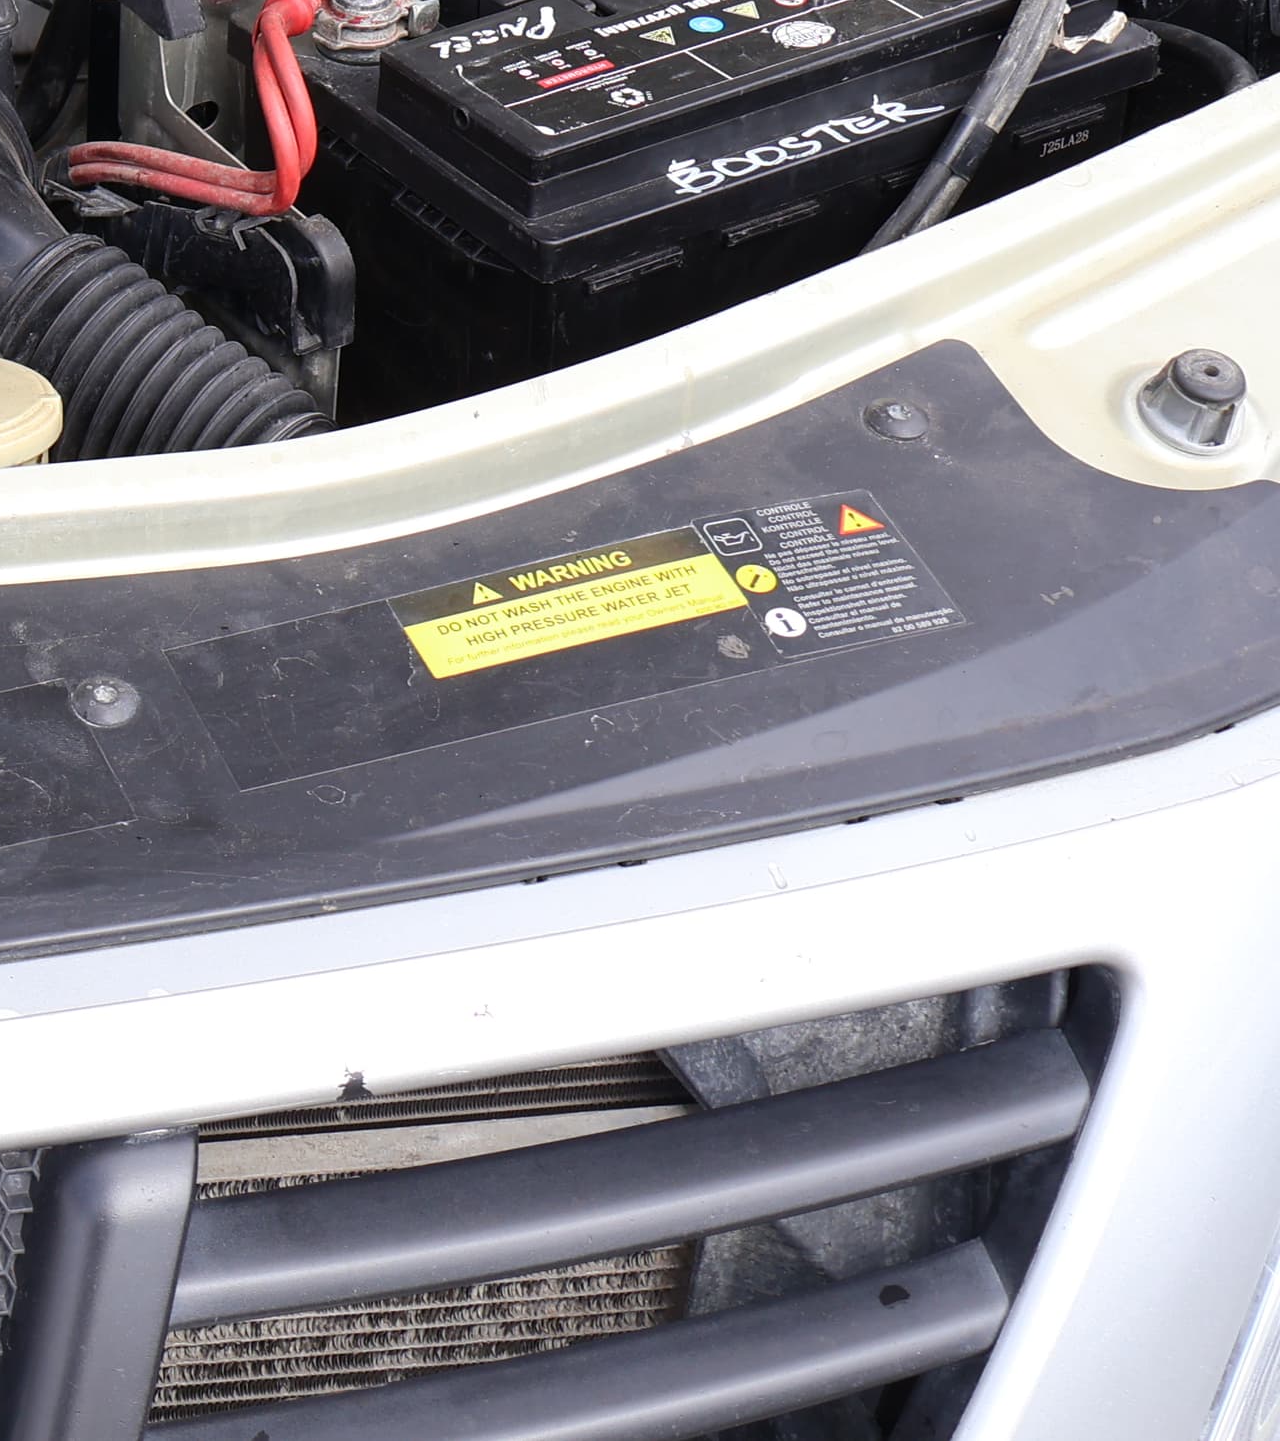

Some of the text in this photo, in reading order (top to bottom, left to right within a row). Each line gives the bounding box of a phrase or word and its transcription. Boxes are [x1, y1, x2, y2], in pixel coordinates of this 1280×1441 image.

[666, 94, 945, 194] BOOSTER
[756, 501, 812, 517] CONTROLE
[767, 509, 819, 523] CONTROL
[760, 517, 824, 534] KONTROLLE
[779, 525, 830, 540] CONTROL
[508, 550, 633, 591] WARNING
[436, 565, 697, 636] DO NOT WASH THE ENGINE WITH
[466, 584, 692, 646] HIGH PRESSURE WATER JET
